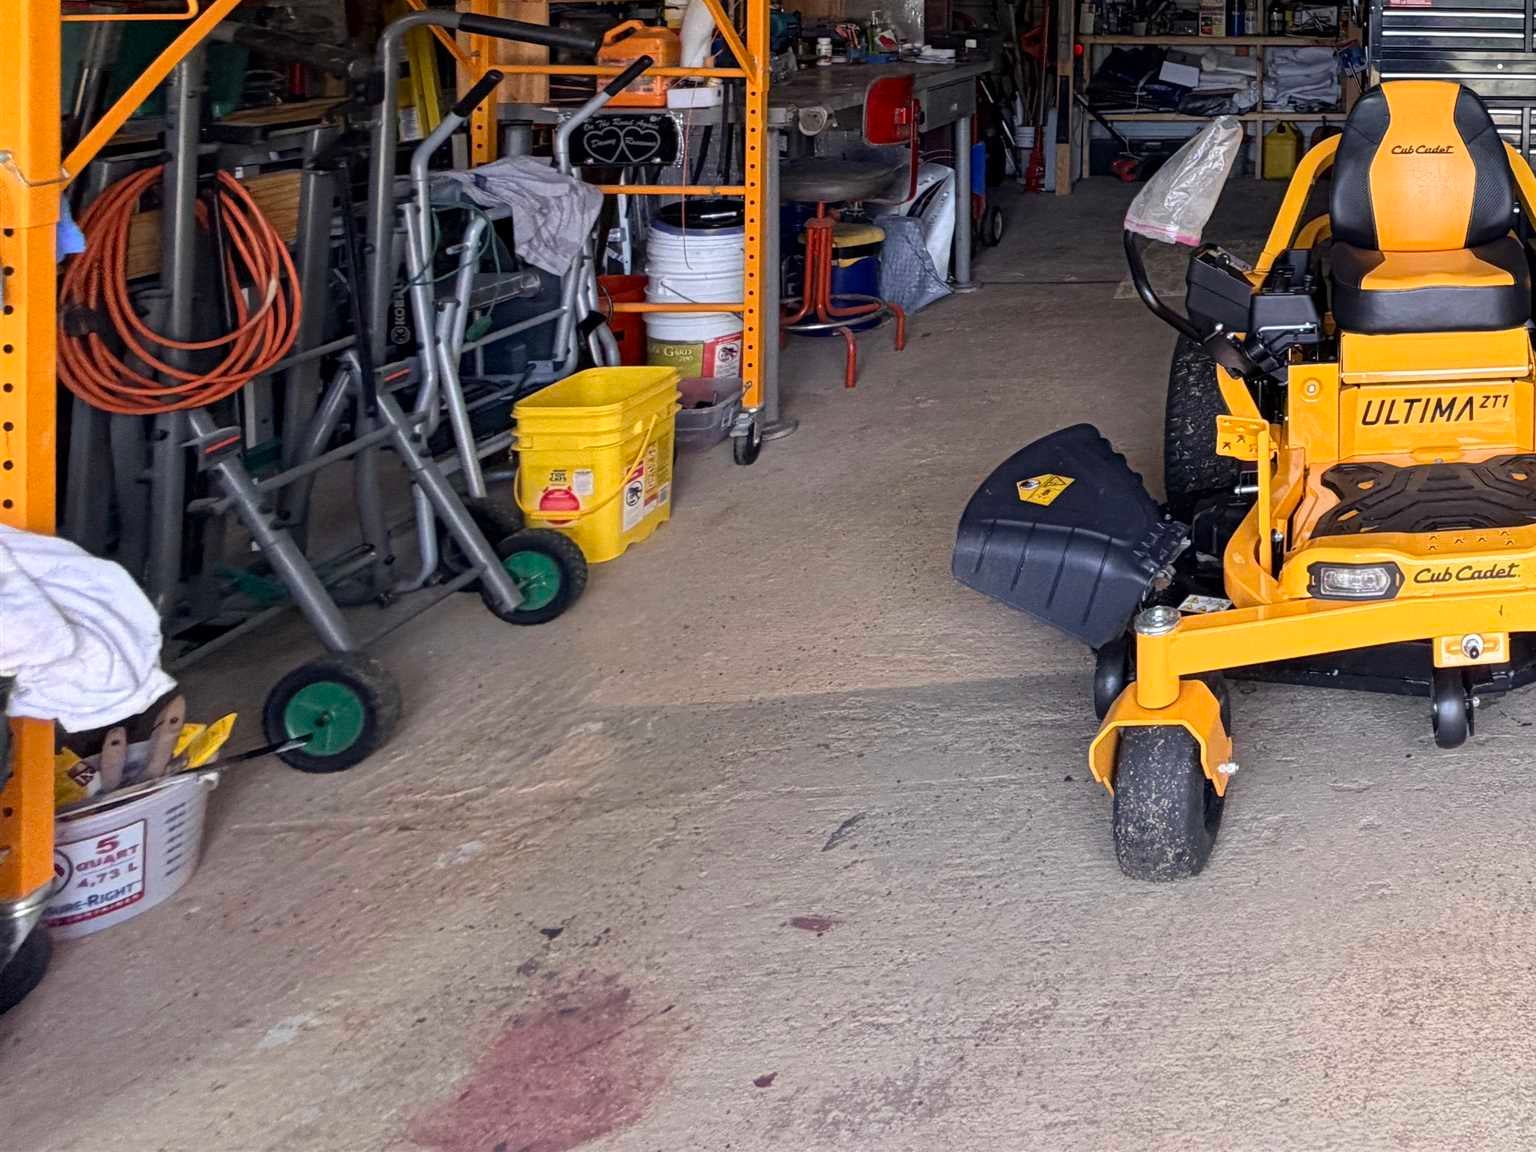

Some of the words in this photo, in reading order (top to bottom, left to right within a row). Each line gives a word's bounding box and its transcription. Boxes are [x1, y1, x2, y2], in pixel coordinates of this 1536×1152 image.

[1391, 145, 1415, 155] Cub
[1415, 145, 1455, 155] Cadet
[1361, 395, 1475, 426] ULTIMA
[1479, 394, 1510, 409] ZT1
[1414, 567, 1453, 585] Cub
[1456, 563, 1521, 582] Cadet
[96, 834, 121, 855] 5
[75, 844, 140, 872] QUART
[127, 862, 138, 873] L
